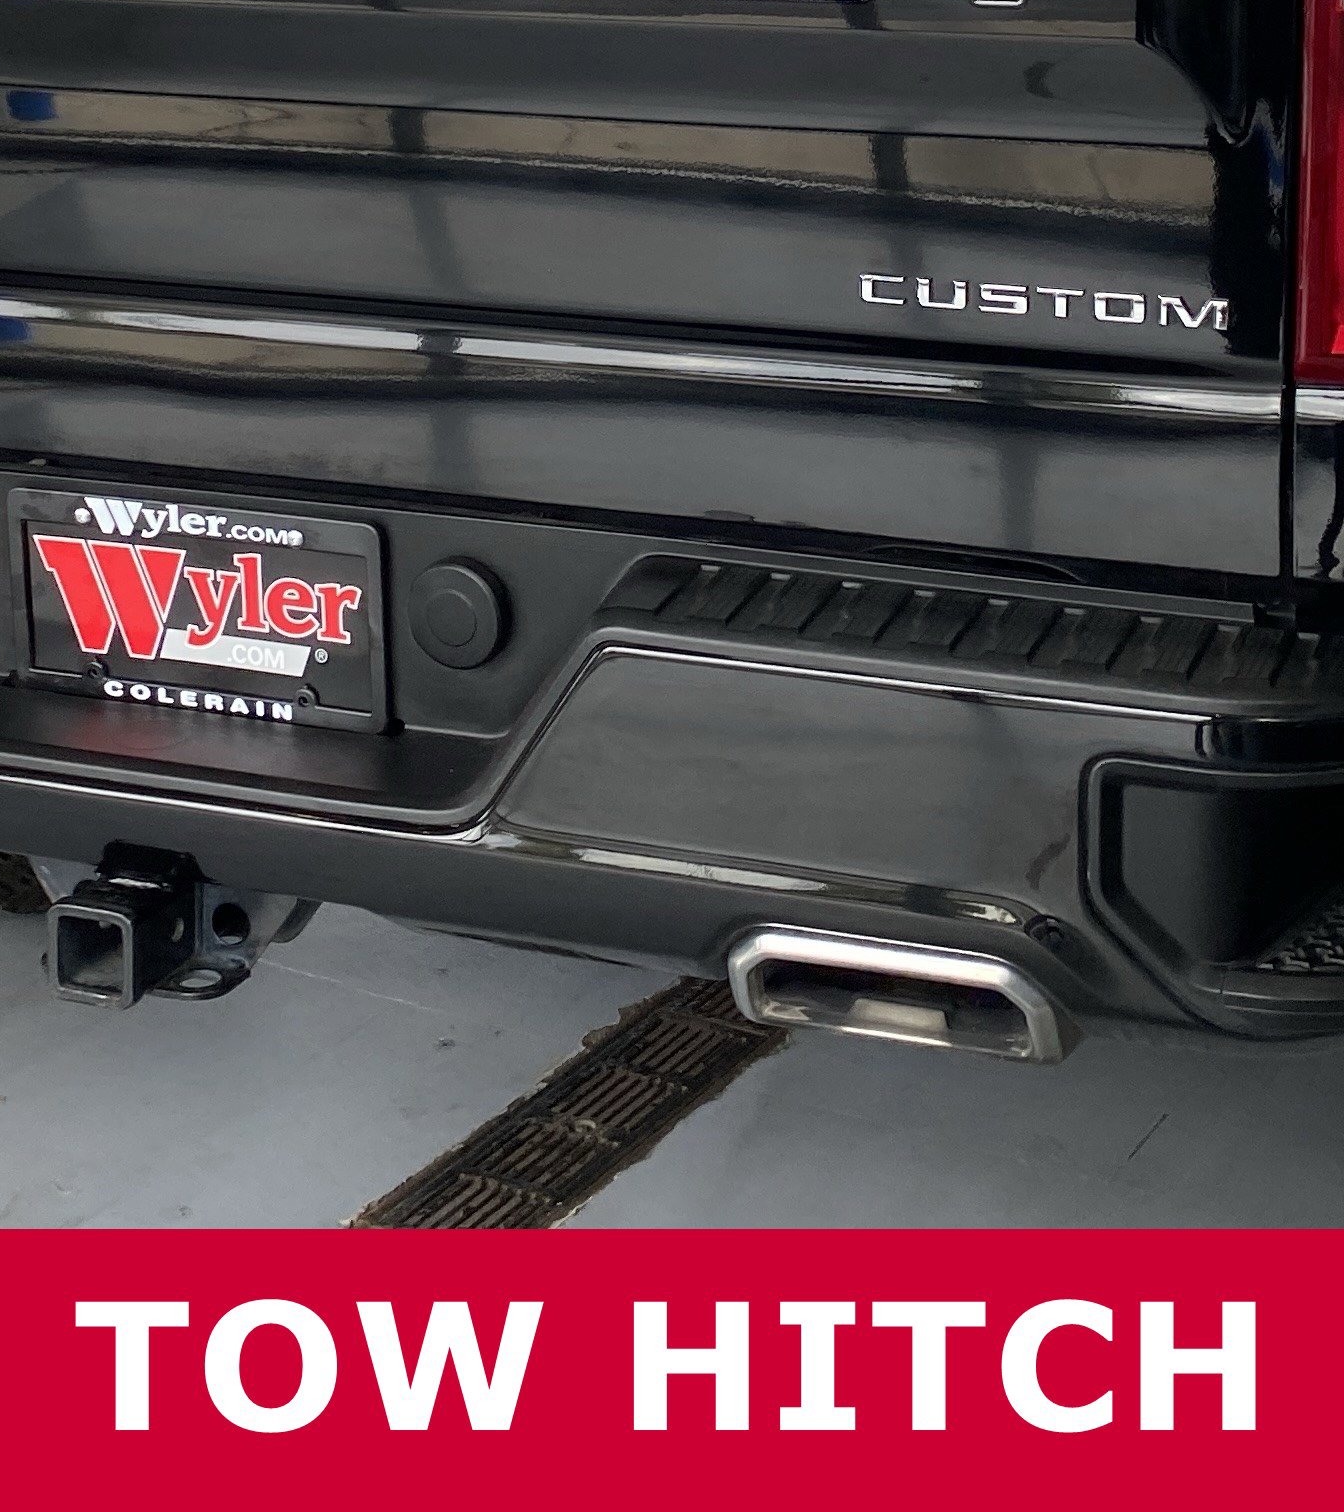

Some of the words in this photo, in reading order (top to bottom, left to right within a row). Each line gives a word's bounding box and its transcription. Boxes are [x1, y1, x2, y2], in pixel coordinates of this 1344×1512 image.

[859, 273, 1229, 331] CUSTOM
[32, 534, 362, 660] Wyler
[103, 679, 293, 721] COLERAIN
